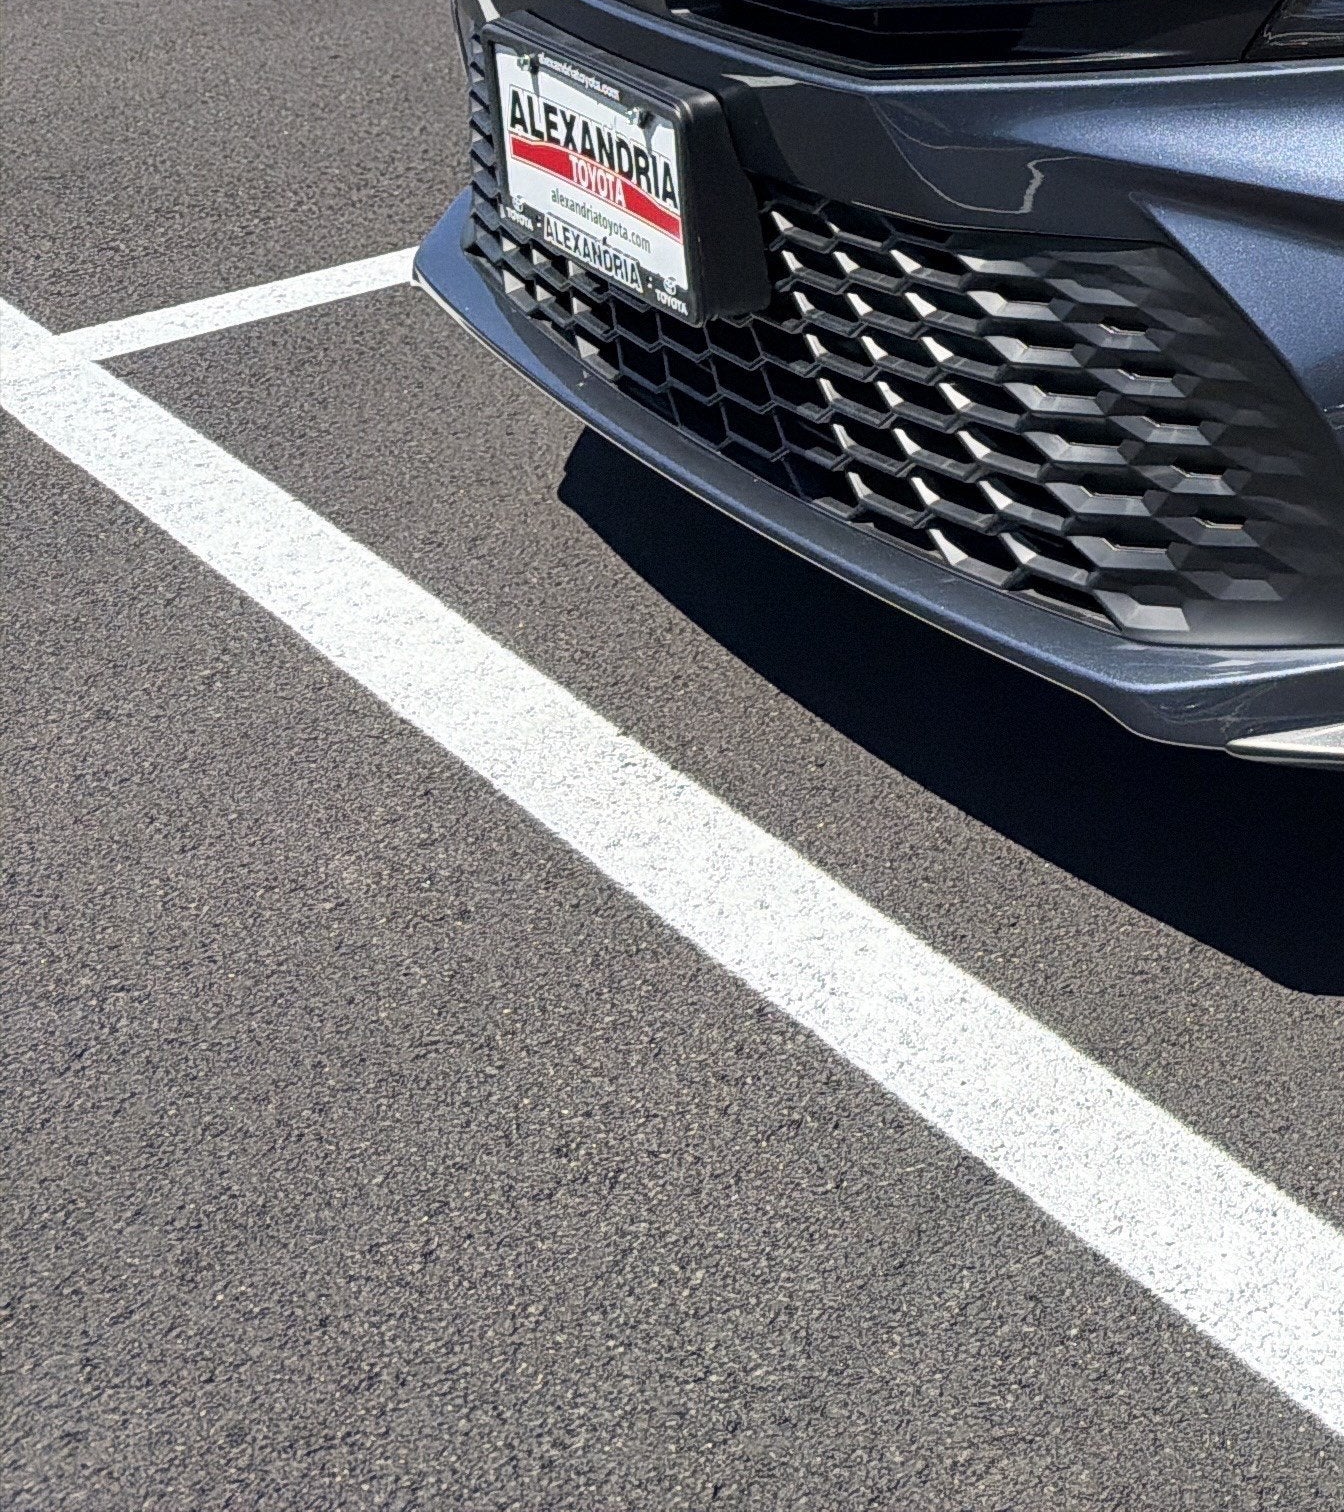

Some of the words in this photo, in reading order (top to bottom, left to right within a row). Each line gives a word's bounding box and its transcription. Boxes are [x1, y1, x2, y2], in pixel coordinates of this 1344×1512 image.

[510, 89, 679, 210] ALEXANDRIA
[568, 153, 627, 209] TOYOTA
[505, 206, 534, 232] TOYOTA
[544, 216, 643, 293] ALEXANDRIA
[655, 289, 688, 316] TOYOTA
[551, 188, 651, 254] alexandriatoyota.com
